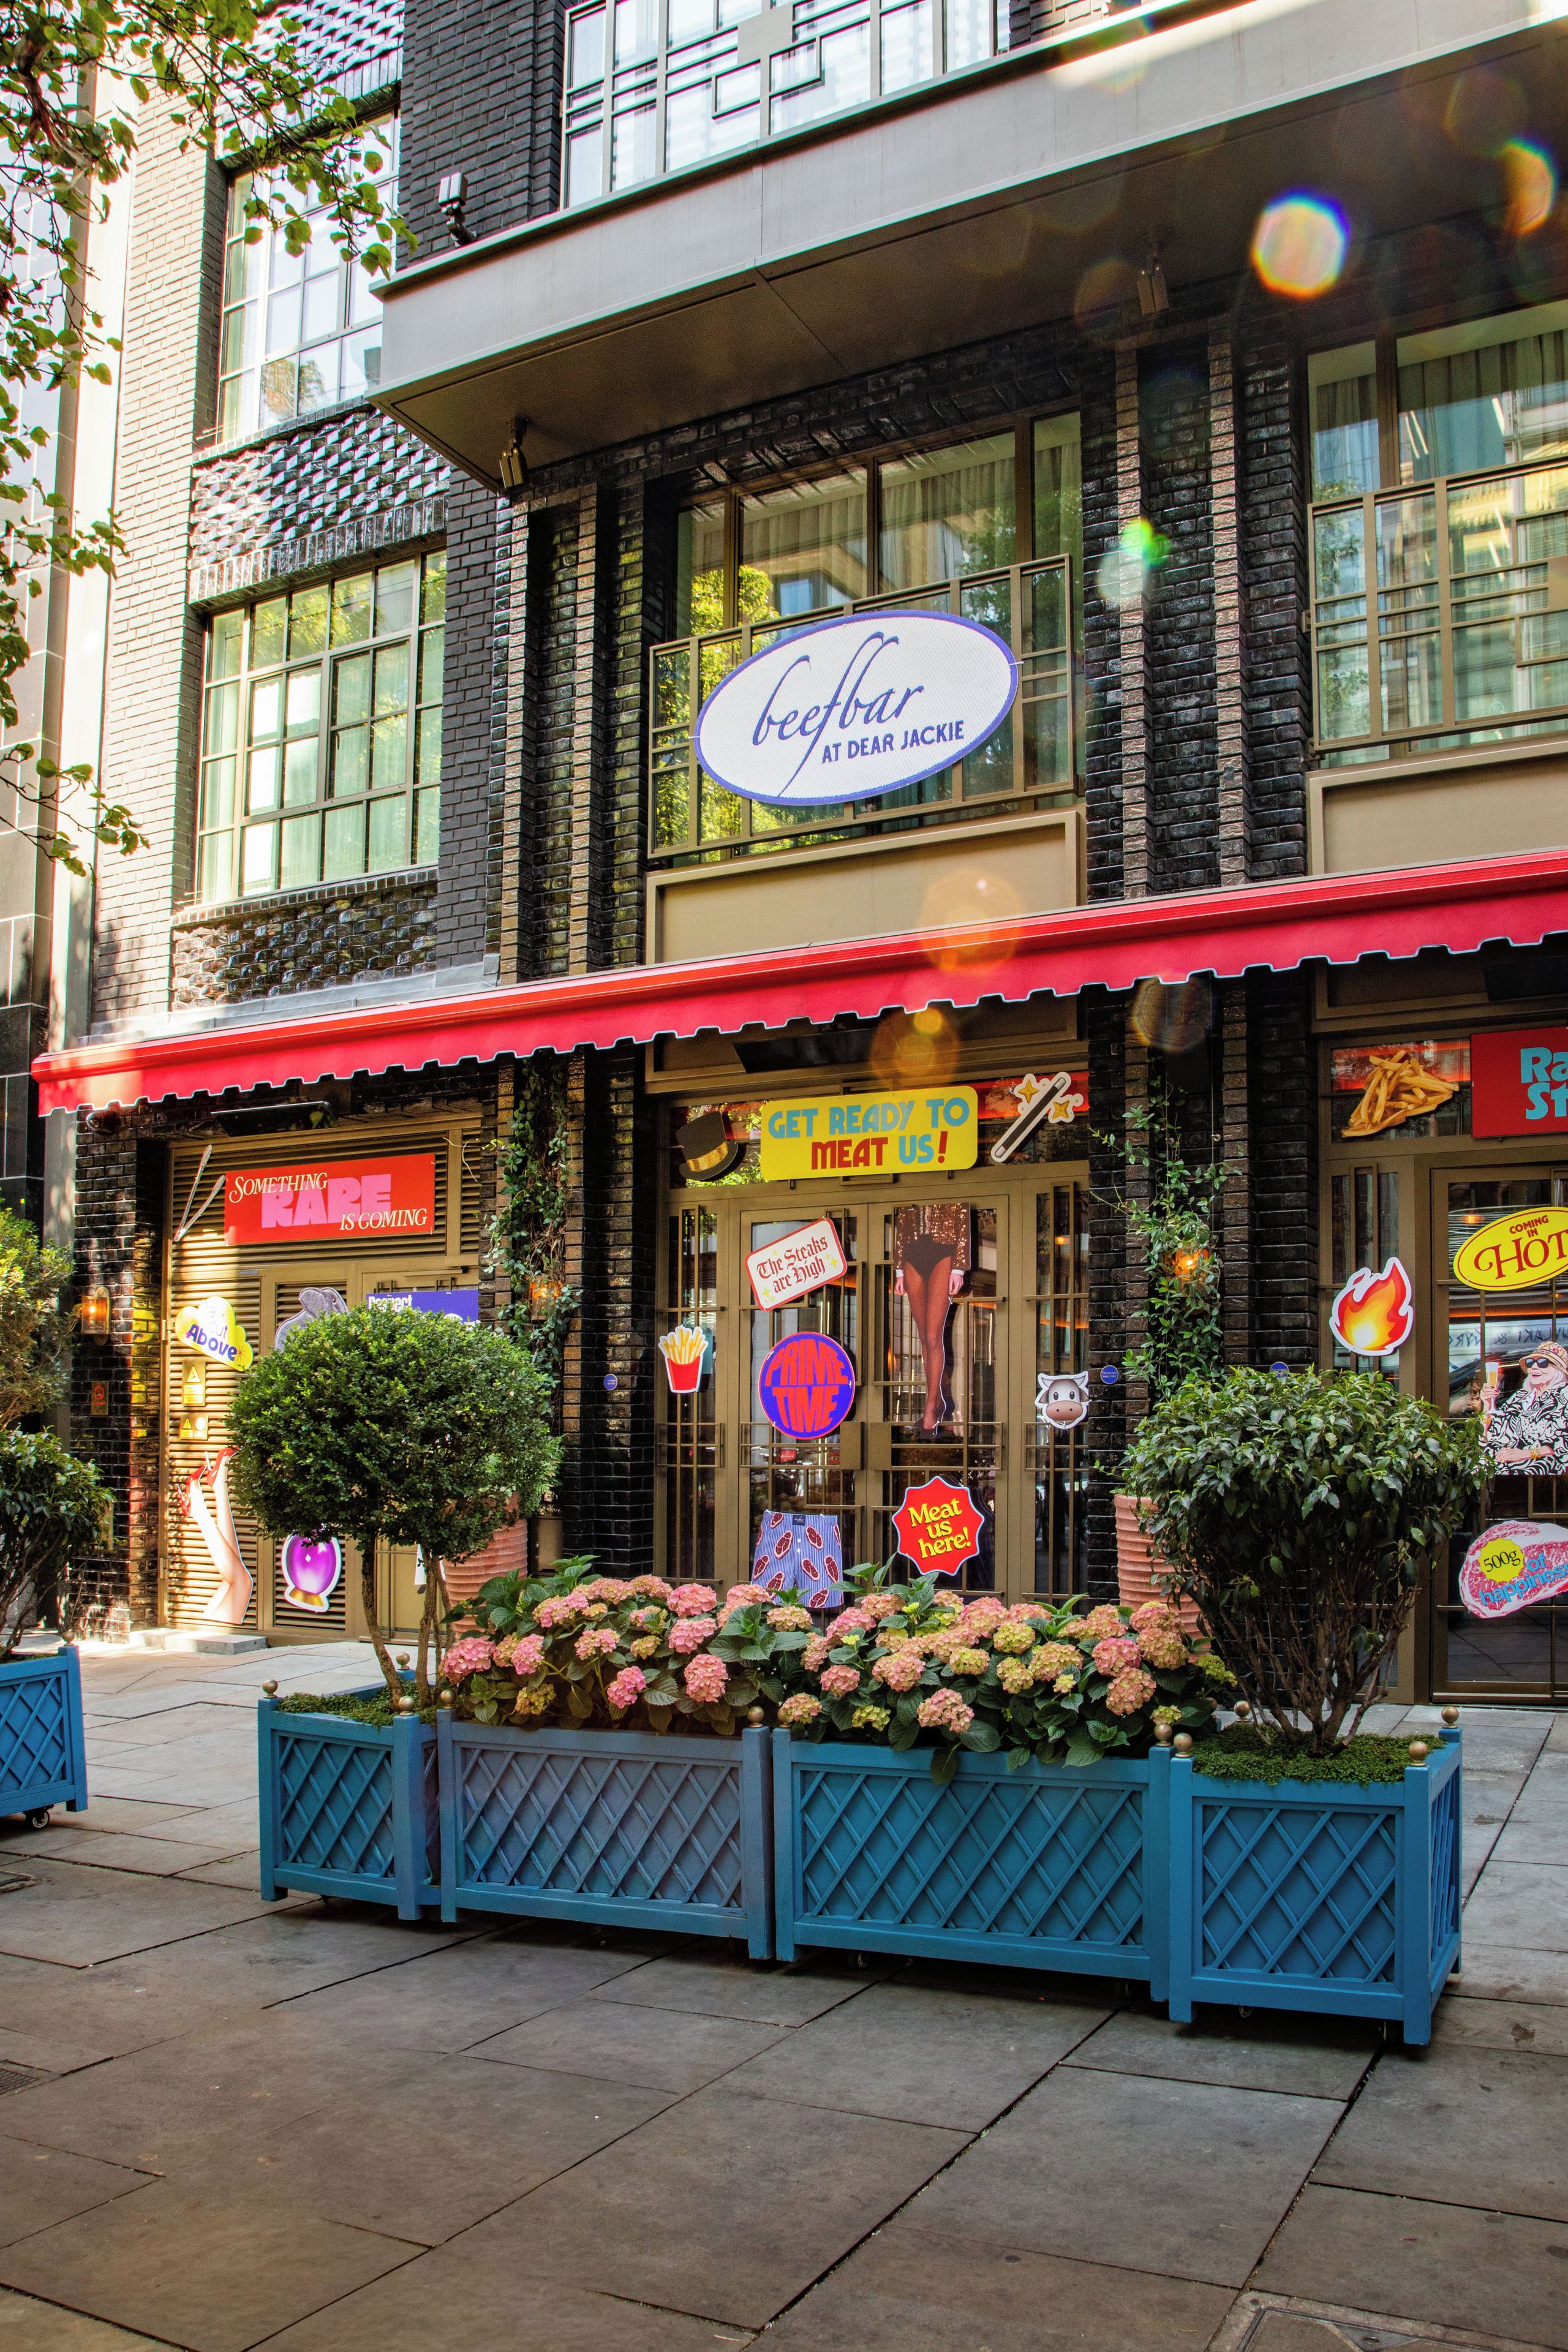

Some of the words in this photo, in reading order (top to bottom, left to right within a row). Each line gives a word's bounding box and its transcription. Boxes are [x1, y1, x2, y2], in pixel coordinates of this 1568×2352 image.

[753, 631, 924, 797] beefbar
[821, 742, 842, 764] AT
[848, 734, 894, 759] DEAR
[900, 720, 965, 750] JACKIE
[768, 1107, 819, 1139] GET
[829, 1100, 916, 1135] READY
[926, 1097, 970, 1128] TO
[812, 1137, 888, 1170] MEAT
[899, 1131, 948, 1164] US!
[229, 1172, 328, 1204] SOMETHING
[262, 1174, 391, 1228] RARE
[339, 1213, 355, 1231] IS
[358, 1208, 428, 1230] COMING
[1509, 1215, 1549, 1234] COMING
[1527, 1228, 1539, 1238] IN
[756, 1257, 783, 1279] The
[784, 1236, 828, 1270] Steaks
[1474, 1229, 1568, 1280] HOT
[773, 1273, 792, 1294] are
[791, 1256, 826, 1284] High
[186, 1324, 238, 1362] Above
[765, 1339, 849, 1387] PRIME
[772, 1385, 839, 1433] TIME
[908, 1498, 962, 1527] Meat
[926, 1520, 952, 1539] us
[918, 1526, 971, 1559] here!
[1483, 1550, 1521, 1572] 500g
[1526, 1552, 1546, 1572] of
